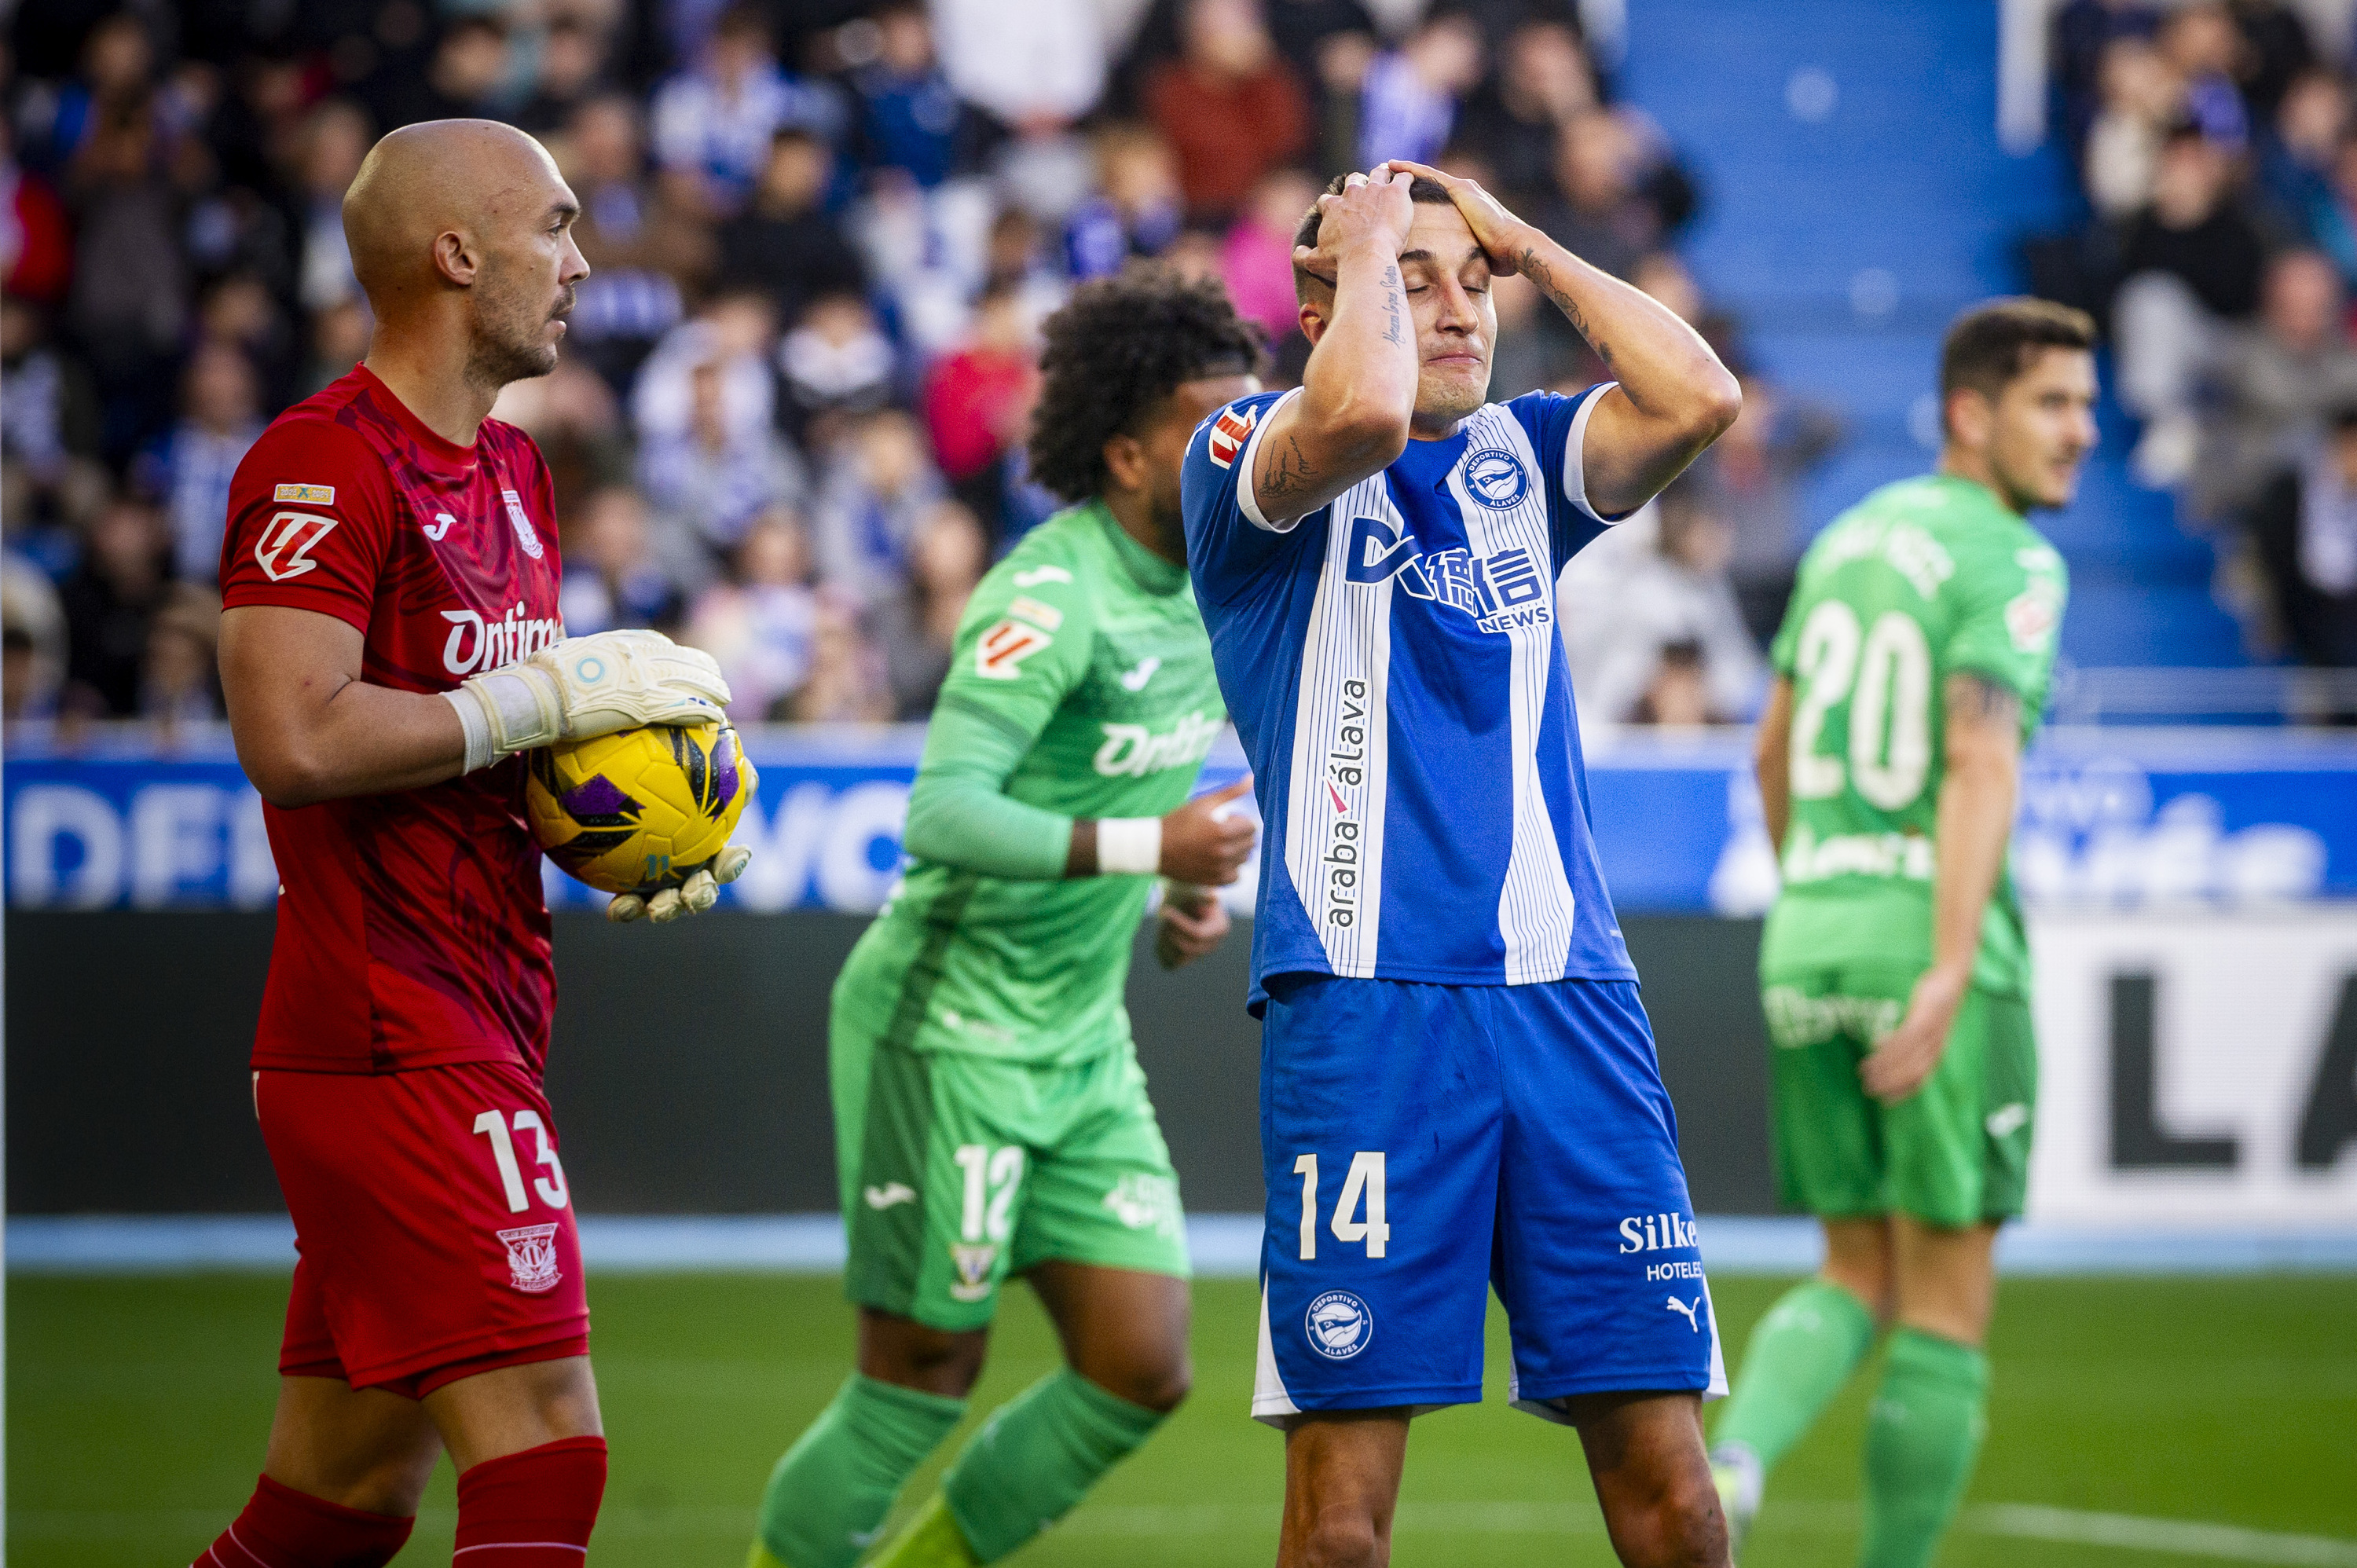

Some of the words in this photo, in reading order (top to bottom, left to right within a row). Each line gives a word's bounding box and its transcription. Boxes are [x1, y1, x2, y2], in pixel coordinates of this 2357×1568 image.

[1468, 452, 1510, 471] DEPORTIVO
[1490, 493, 1520, 507] ALAVÉS
[440, 600, 559, 675] Ontim
[1480, 607, 1550, 632] NEWS
[1329, 679, 1365, 786] álava
[1790, 597, 1933, 811] 20
[1323, 821, 1359, 928] araba
[473, 1109, 568, 1213] 13
[954, 1144, 1025, 1243] 12
[1293, 1151, 1390, 1260] 14
[1313, 1295, 1358, 1312] DEPORTIVO
[1647, 1262, 1703, 1281] HOTELES
[1324, 1343, 1358, 1356] ALAVÉS
